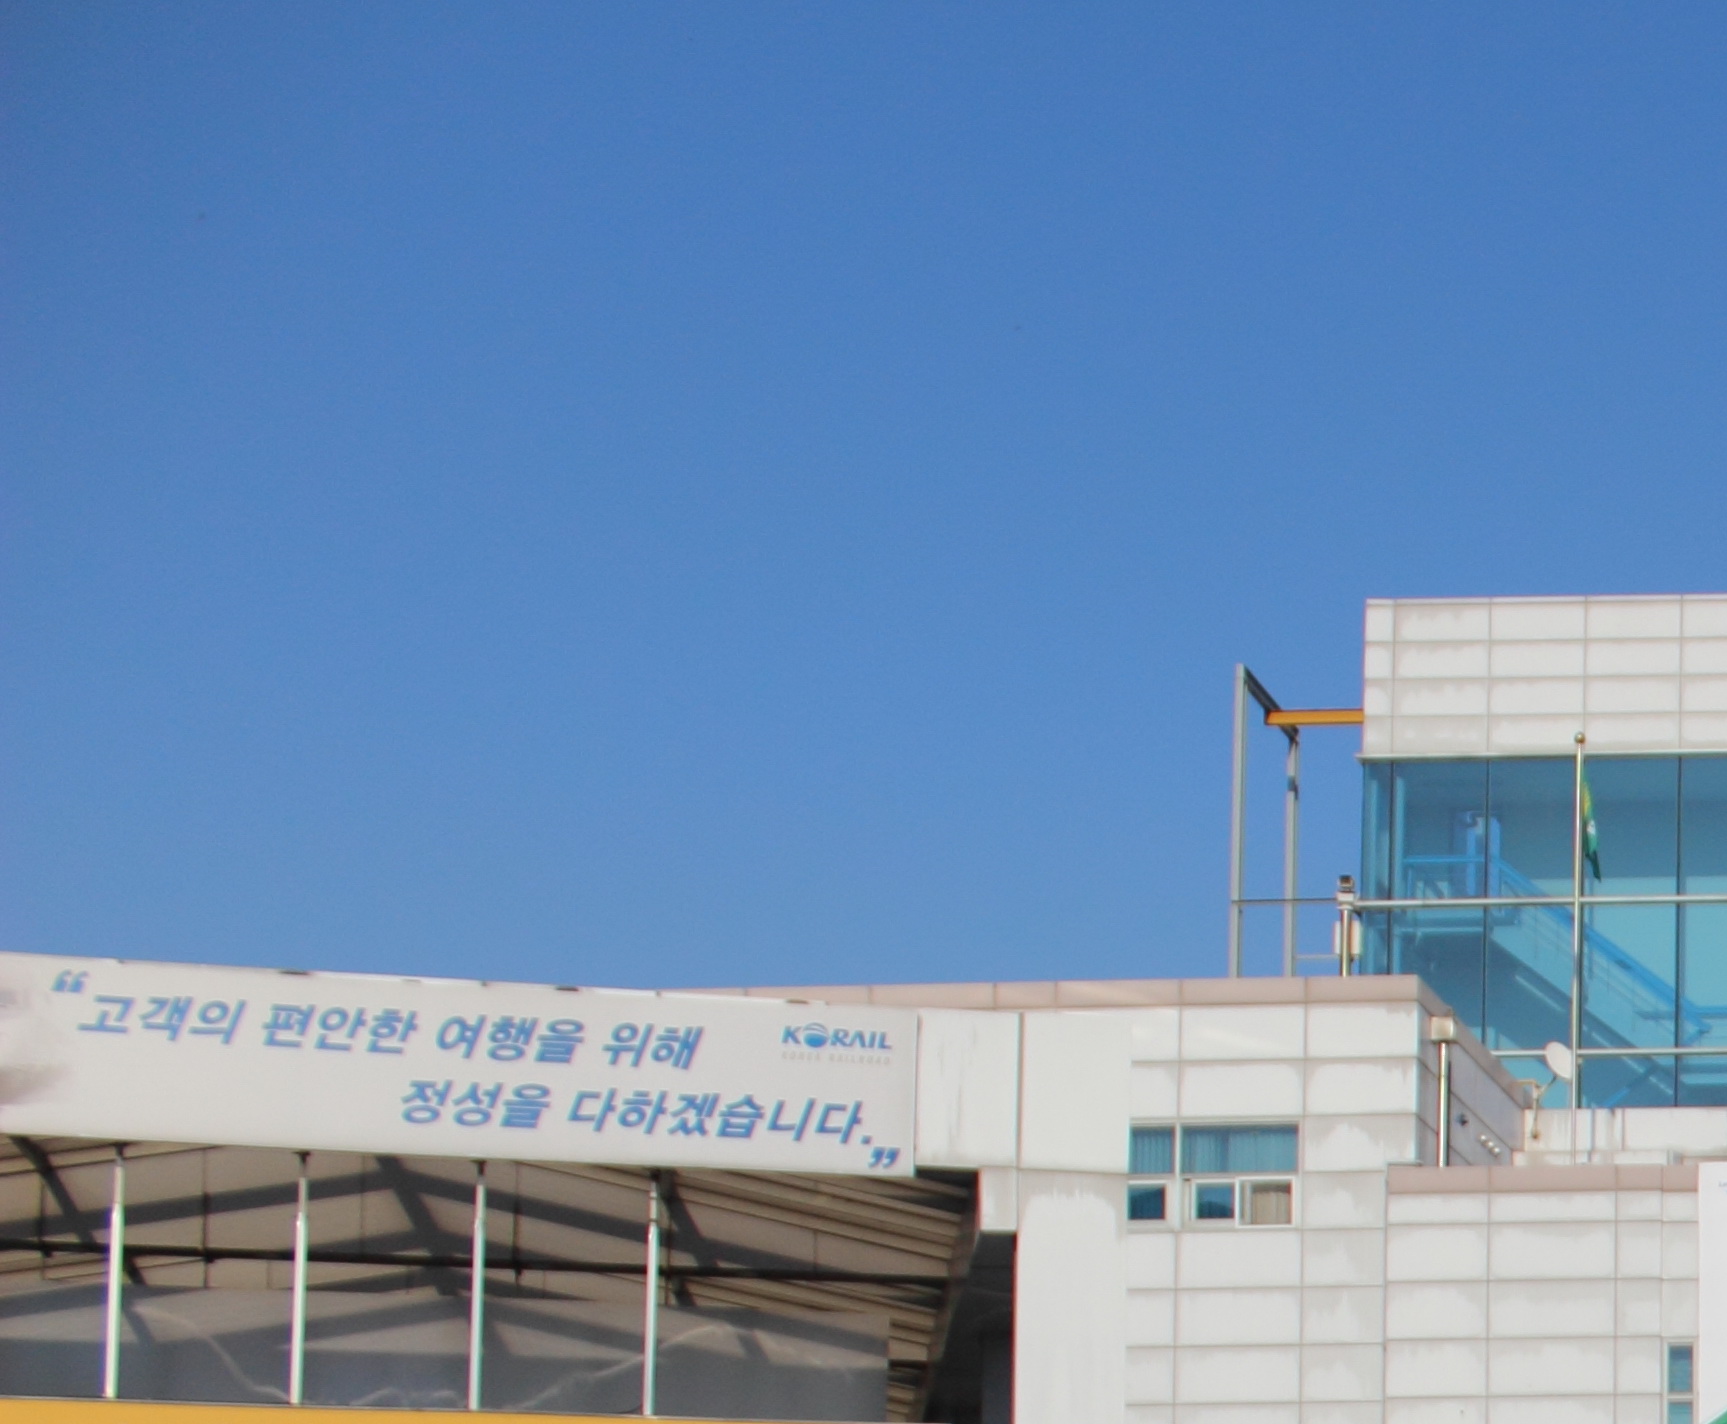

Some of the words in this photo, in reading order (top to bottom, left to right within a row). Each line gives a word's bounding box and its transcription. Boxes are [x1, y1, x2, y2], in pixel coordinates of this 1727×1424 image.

[259, 1001, 418, 1058] 편안한
[435, 1013, 587, 1068] 여행을
[600, 1020, 706, 1072] 위해
[780, 1020, 894, 1052] KORAIL
[400, 1078, 553, 1130] 정성을
